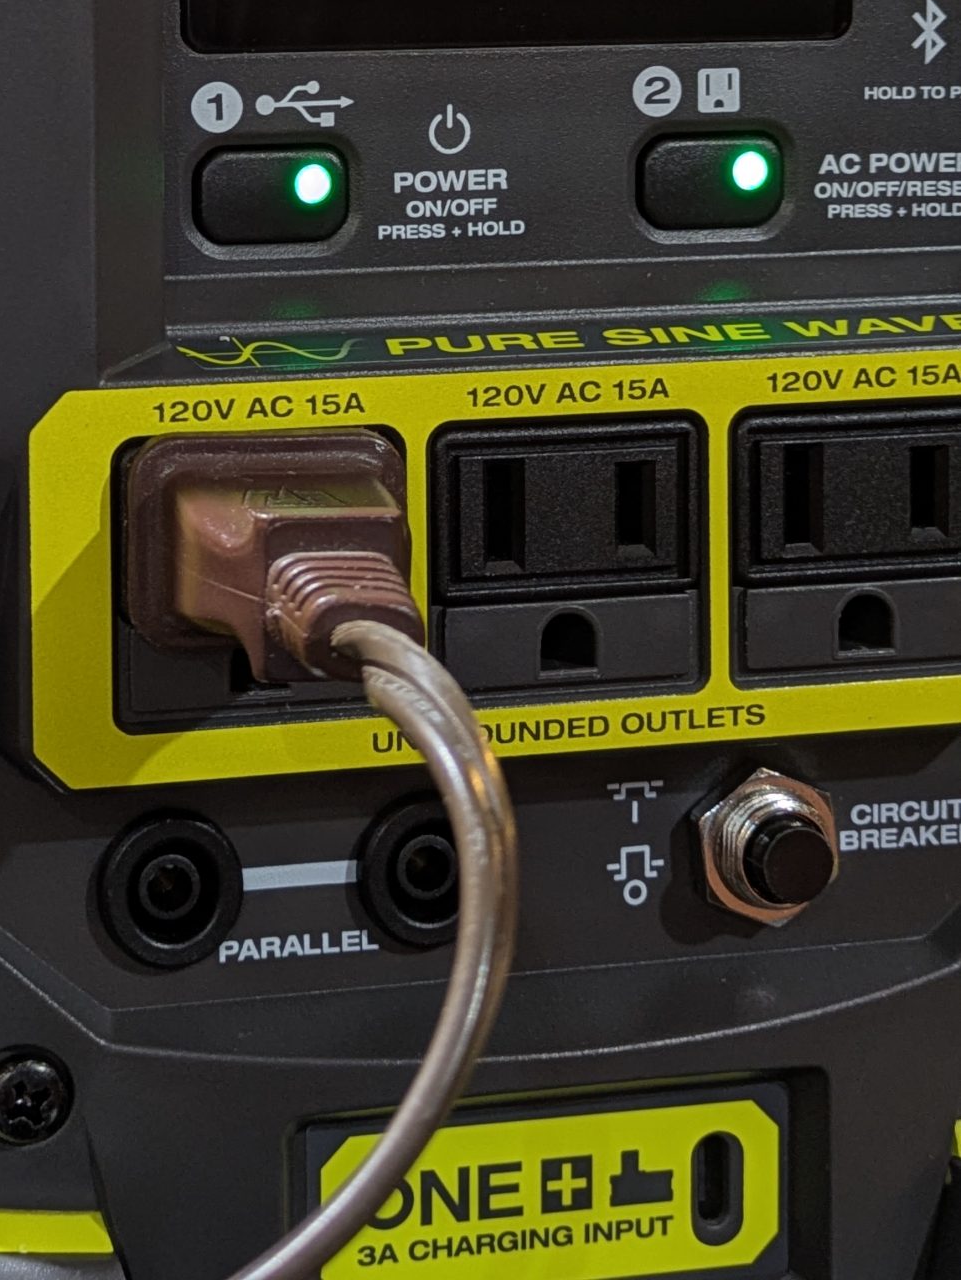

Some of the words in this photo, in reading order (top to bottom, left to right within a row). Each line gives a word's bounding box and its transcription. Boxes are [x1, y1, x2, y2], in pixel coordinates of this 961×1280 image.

[864, 86, 917, 100] HOLD
[919, 85, 946, 100] TO
[818, 153, 862, 175] AC
[869, 152, 961, 174] POWE
[393, 168, 509, 194] POWER
[405, 197, 498, 218] ON/OFF
[827, 203, 893, 219] PRESS
[897, 206, 908, 217] +
[911, 202, 961, 217] HOLD
[377, 223, 446, 240] PRESS
[451, 226, 462, 238] +
[467, 220, 526, 237] HOLD
[385, 329, 586, 356] PURE
[601, 322, 772, 347] SINE
[766, 370, 843, 393] 120V
[853, 366, 896, 389] AC
[907, 362, 961, 386] 15A
[467, 384, 547, 408] 120V
[556, 380, 601, 404] AC
[612, 377, 670, 401] 15A
[153, 398, 236, 423] 120V
[246, 395, 294, 419] AC
[305, 392, 366, 417] 15A
[371, 714, 611, 754] UNUNDED
[620, 703, 766, 734] OUTLETS
[850, 799, 961, 825] CIRCUIT
[839, 824, 961, 852] BREAKE
[219, 929, 380, 963] PARALLEL
[356, 1242, 400, 1267] 3A
[407, 1225, 574, 1261] CHARGING
[584, 1215, 675, 1244] INPUT
